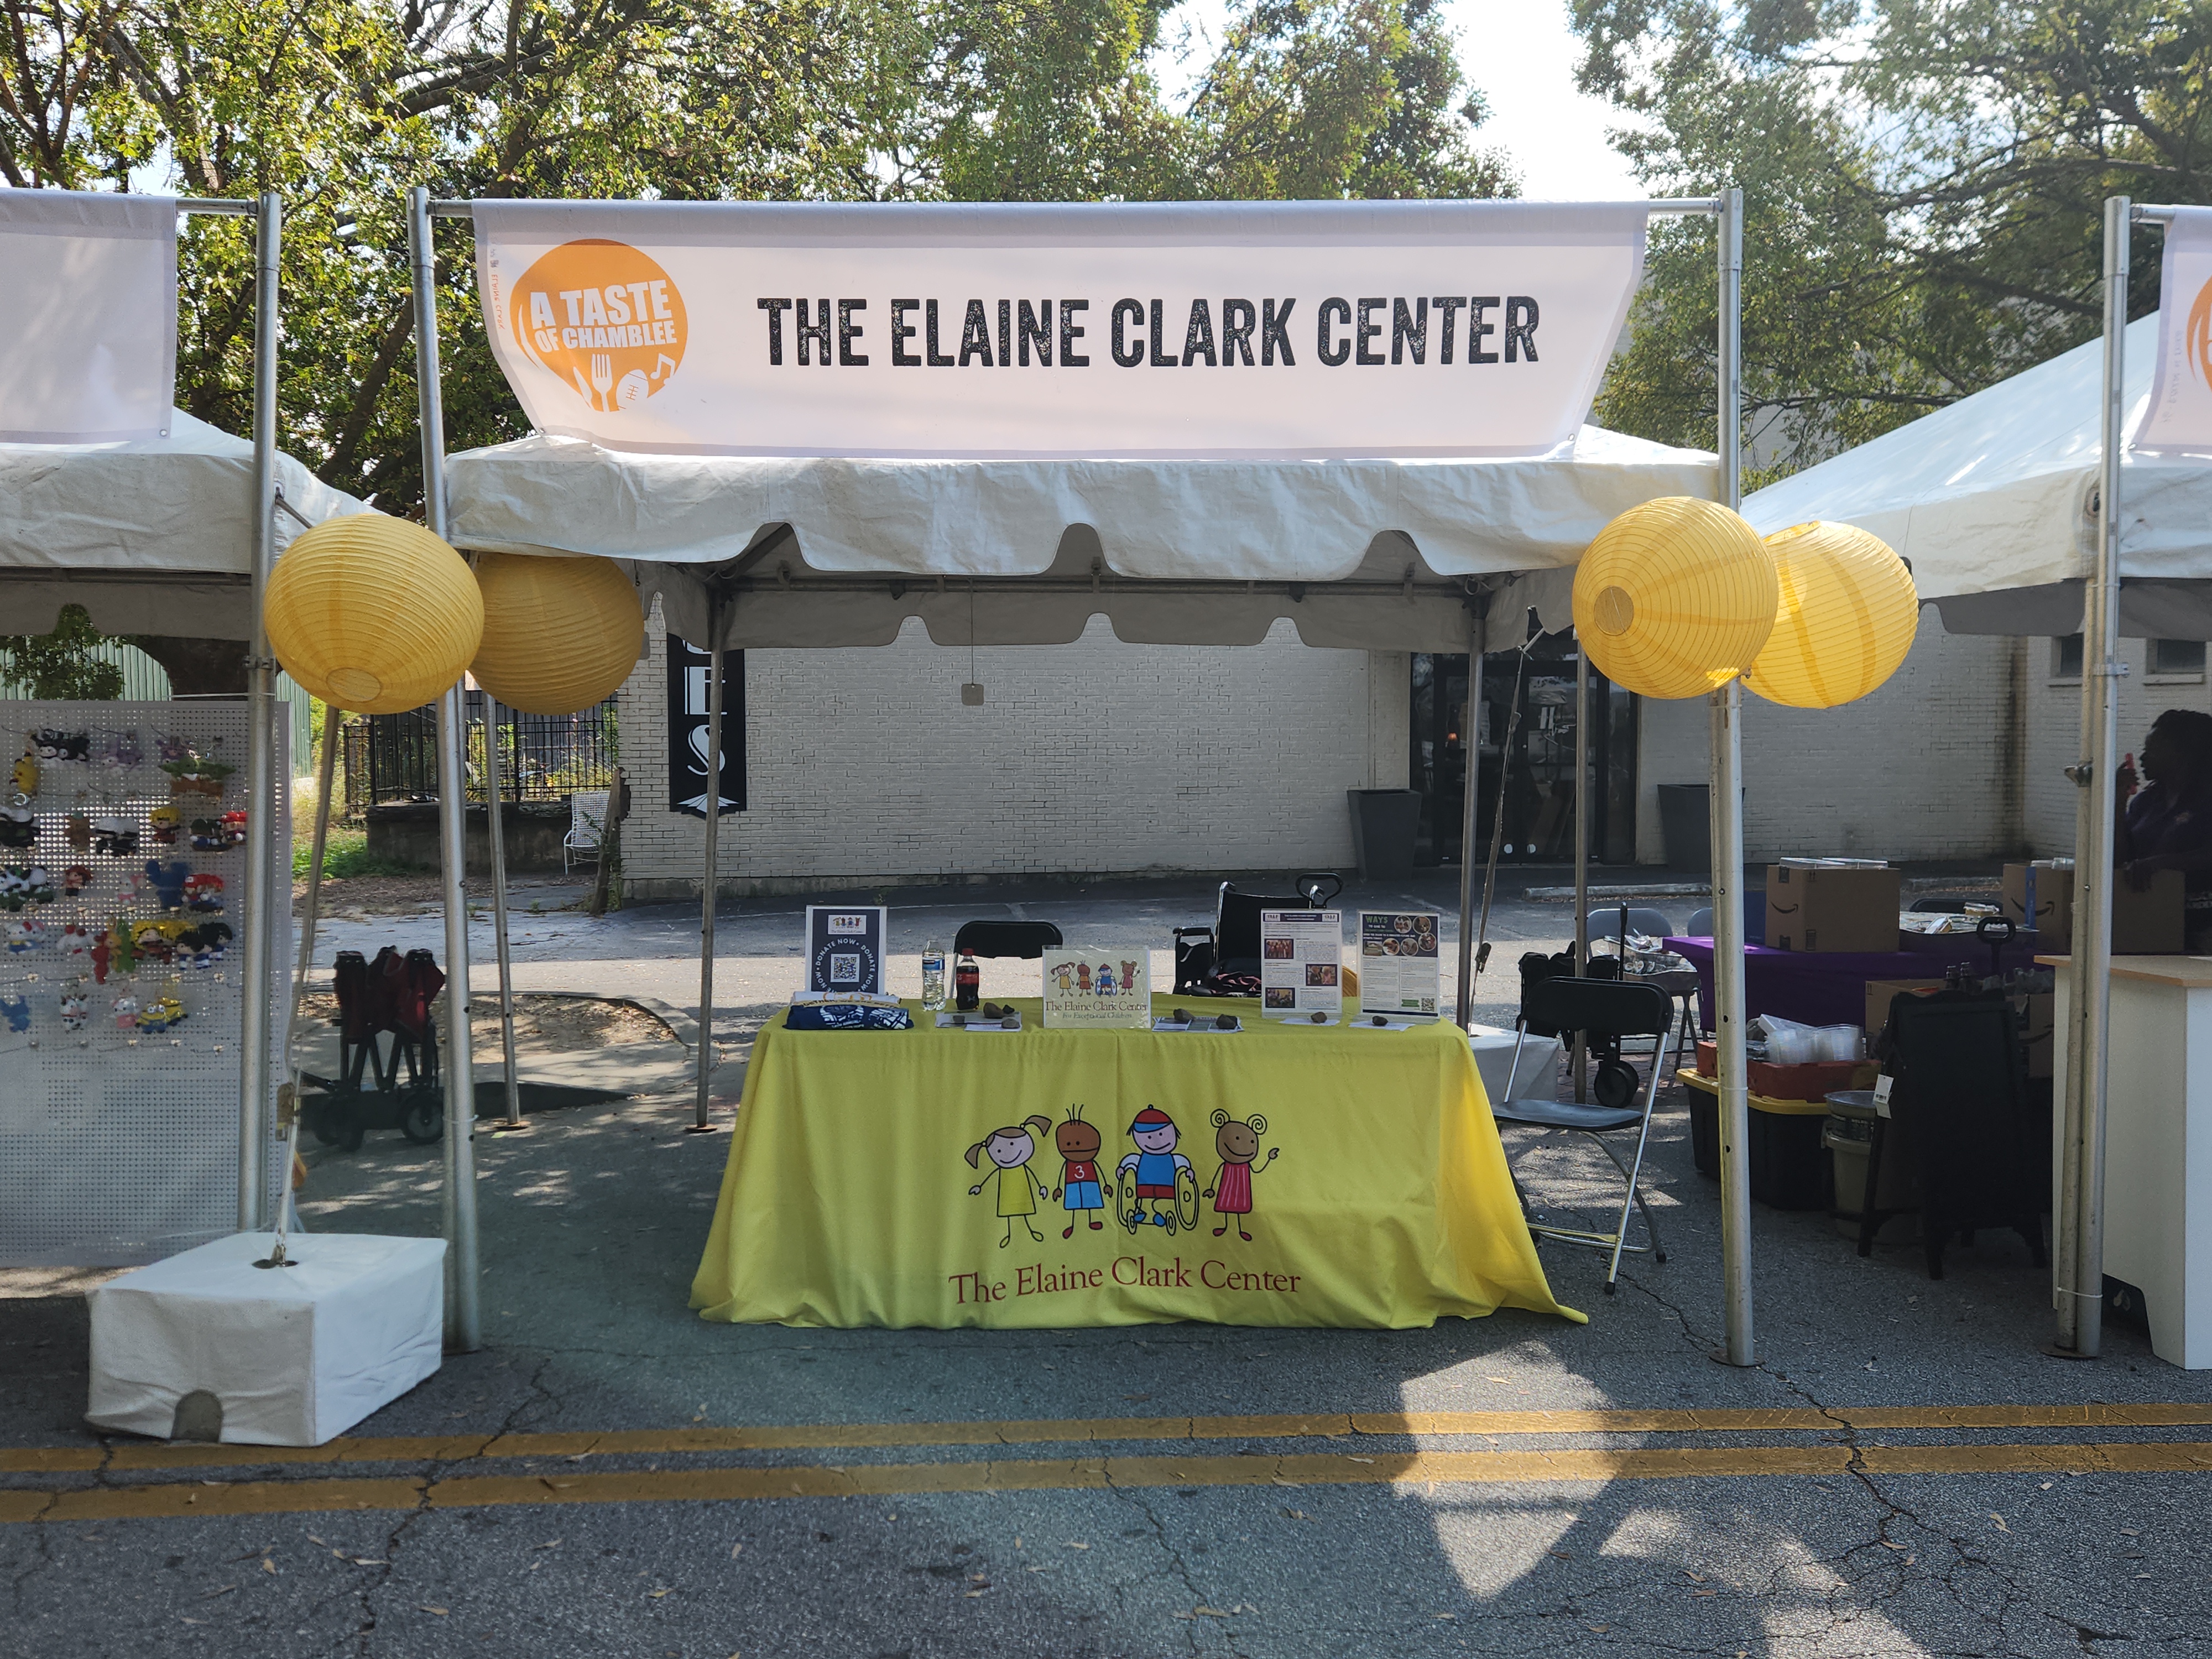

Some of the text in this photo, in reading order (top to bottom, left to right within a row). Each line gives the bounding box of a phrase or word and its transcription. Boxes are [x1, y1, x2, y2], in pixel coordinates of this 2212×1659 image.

[530, 280, 672, 329] A TASTE
[534, 320, 677, 353] OF CHAMBLEE
[757, 296, 1538, 367] THE ELAINE CLARK CENTER
[1365, 915, 1388, 924] WAYS
[816, 941, 836, 966] DONATE
[860, 945, 875, 972] DONATE
[1045, 1001, 1147, 1011] The Elaine Clark Center
[1074, 1165, 1084, 1178] 3
[948, 1256, 1301, 1305] The Elaine Clark Center
